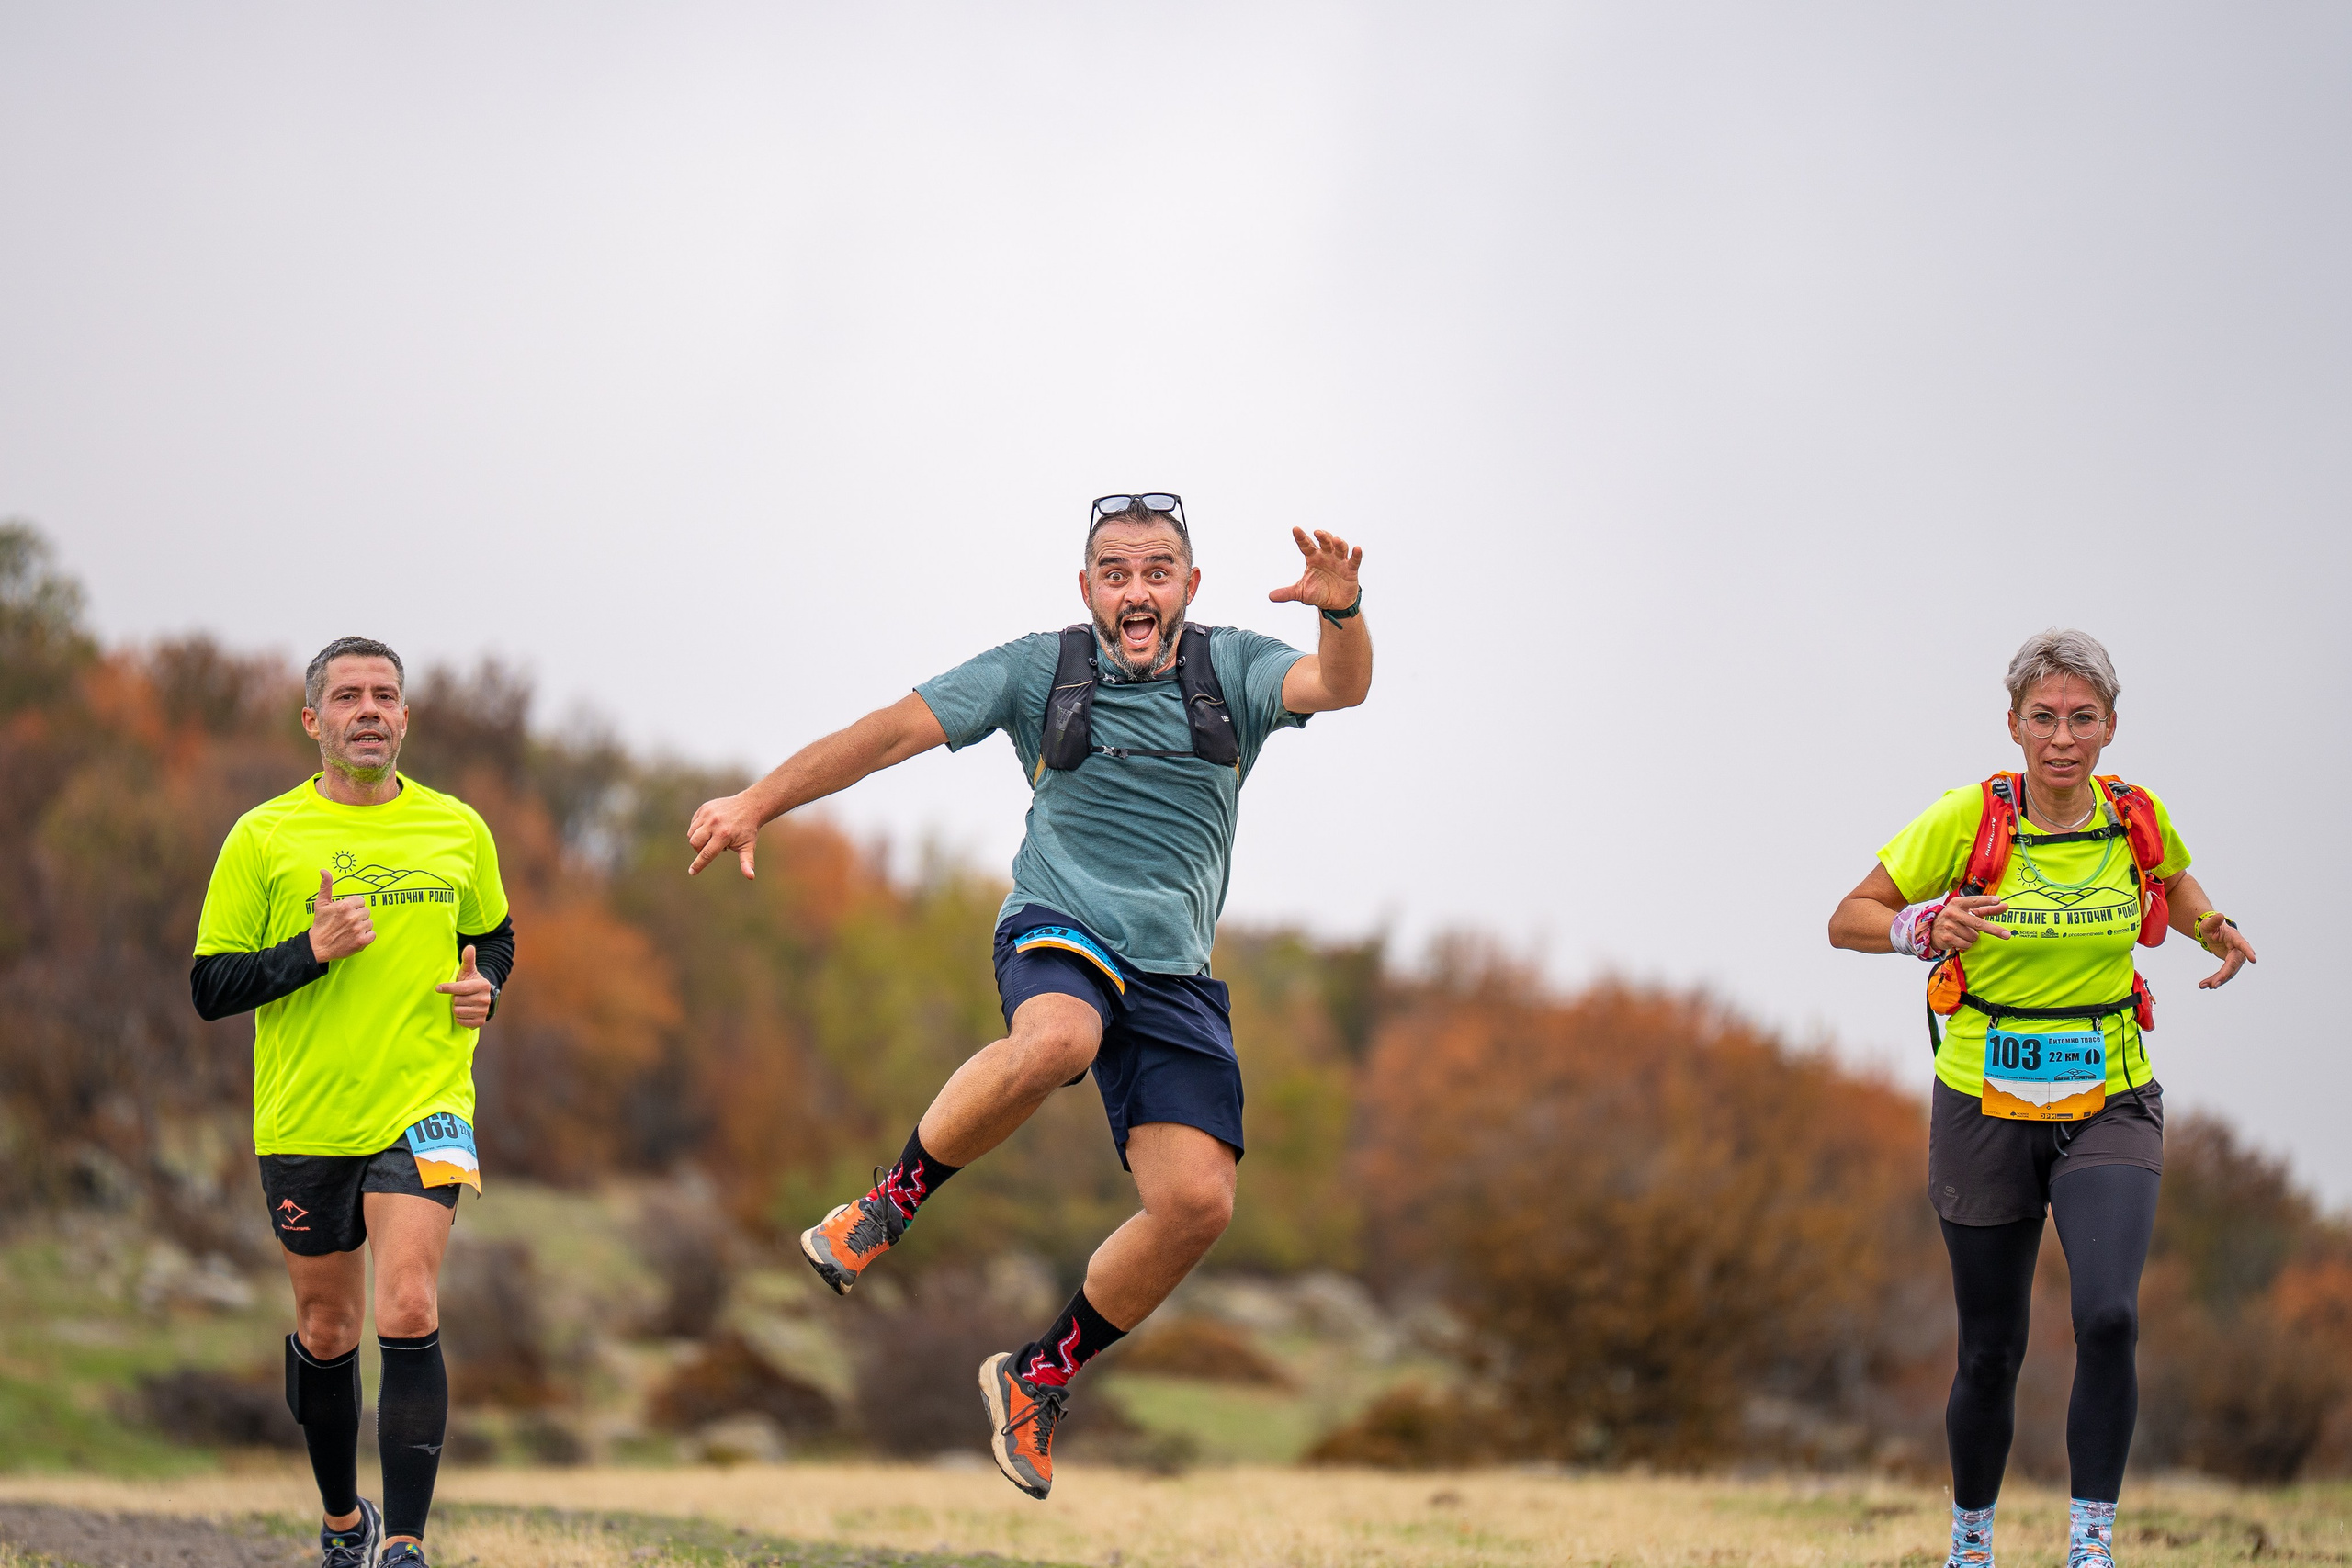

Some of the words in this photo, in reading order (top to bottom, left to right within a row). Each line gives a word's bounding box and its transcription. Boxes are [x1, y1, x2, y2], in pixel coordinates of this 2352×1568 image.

[371, 895, 376, 907] В
[382, 891, 424, 906] ИЗТОЧНИ
[2053, 911, 2060, 925] В
[2067, 908, 2113, 925] ИЗТОЧНИ
[1989, 1034, 2041, 1071] 103
[2048, 1051, 2063, 1063] 22
[412, 1111, 459, 1144] 163
